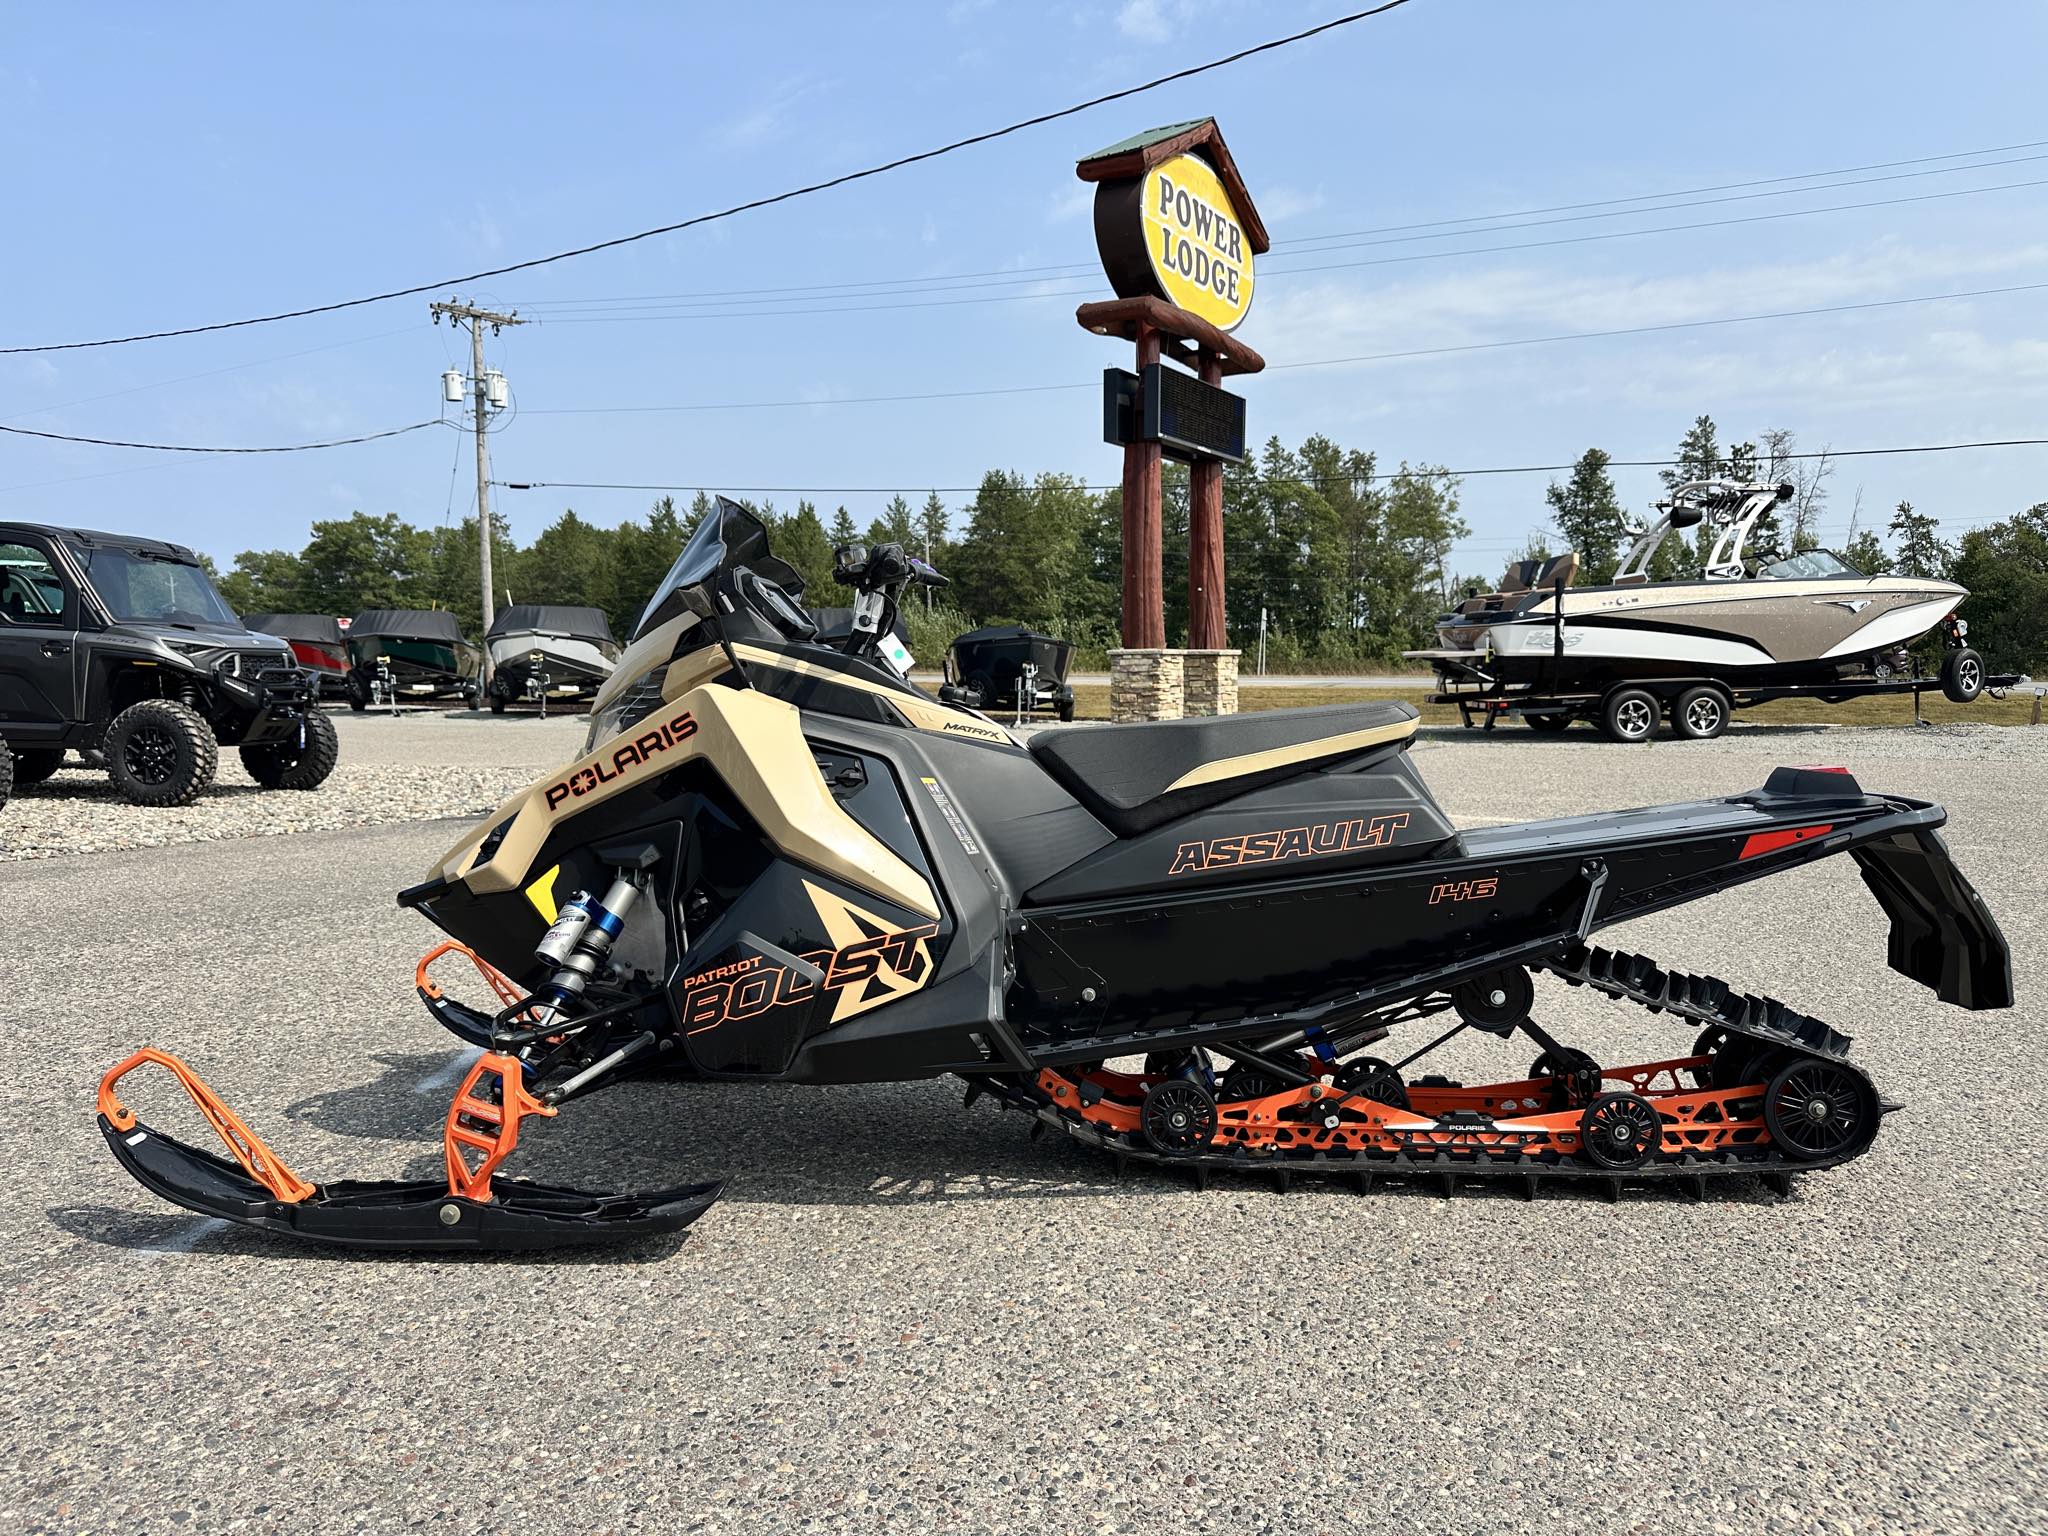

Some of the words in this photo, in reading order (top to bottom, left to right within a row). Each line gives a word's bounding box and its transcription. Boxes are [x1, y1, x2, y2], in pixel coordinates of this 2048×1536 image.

[1159, 175, 1242, 264] POWER
[1162, 227, 1239, 305] LODGE
[544, 711, 699, 812] POLARIS
[943, 722, 999, 740] MATRYX
[1168, 813, 1410, 875] ASSAULT
[1428, 878, 1498, 905] 146
[683, 955, 763, 989] PATRIOT
[683, 923, 940, 1036] BOOST
